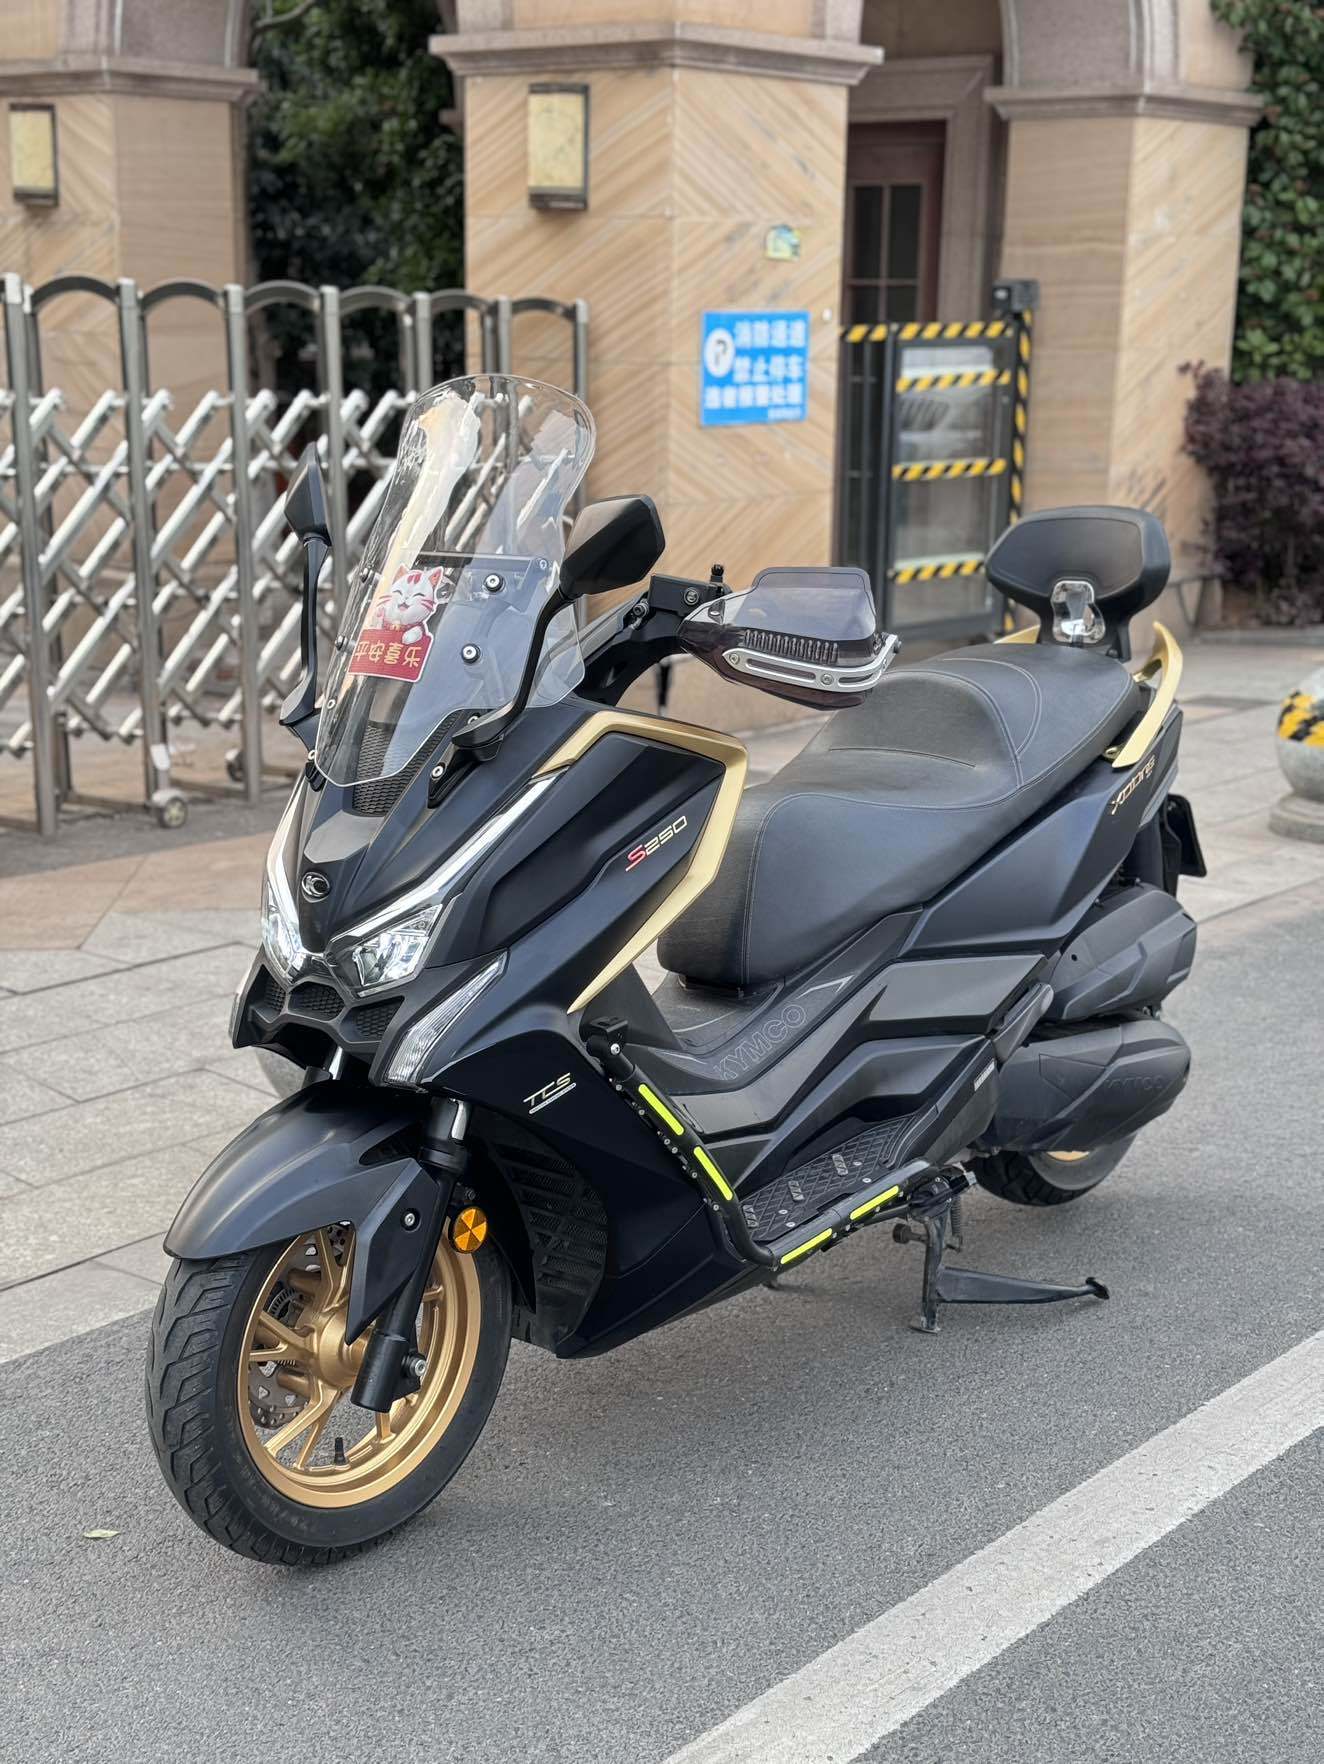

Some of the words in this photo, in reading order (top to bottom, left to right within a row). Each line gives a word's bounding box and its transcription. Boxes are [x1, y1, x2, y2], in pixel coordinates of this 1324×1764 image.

[355, 640, 422, 668] 平安喜乐
[625, 816, 687, 872] S250
[713, 1004, 806, 1081] KYMCO
[523, 1072, 571, 1107] TCS
